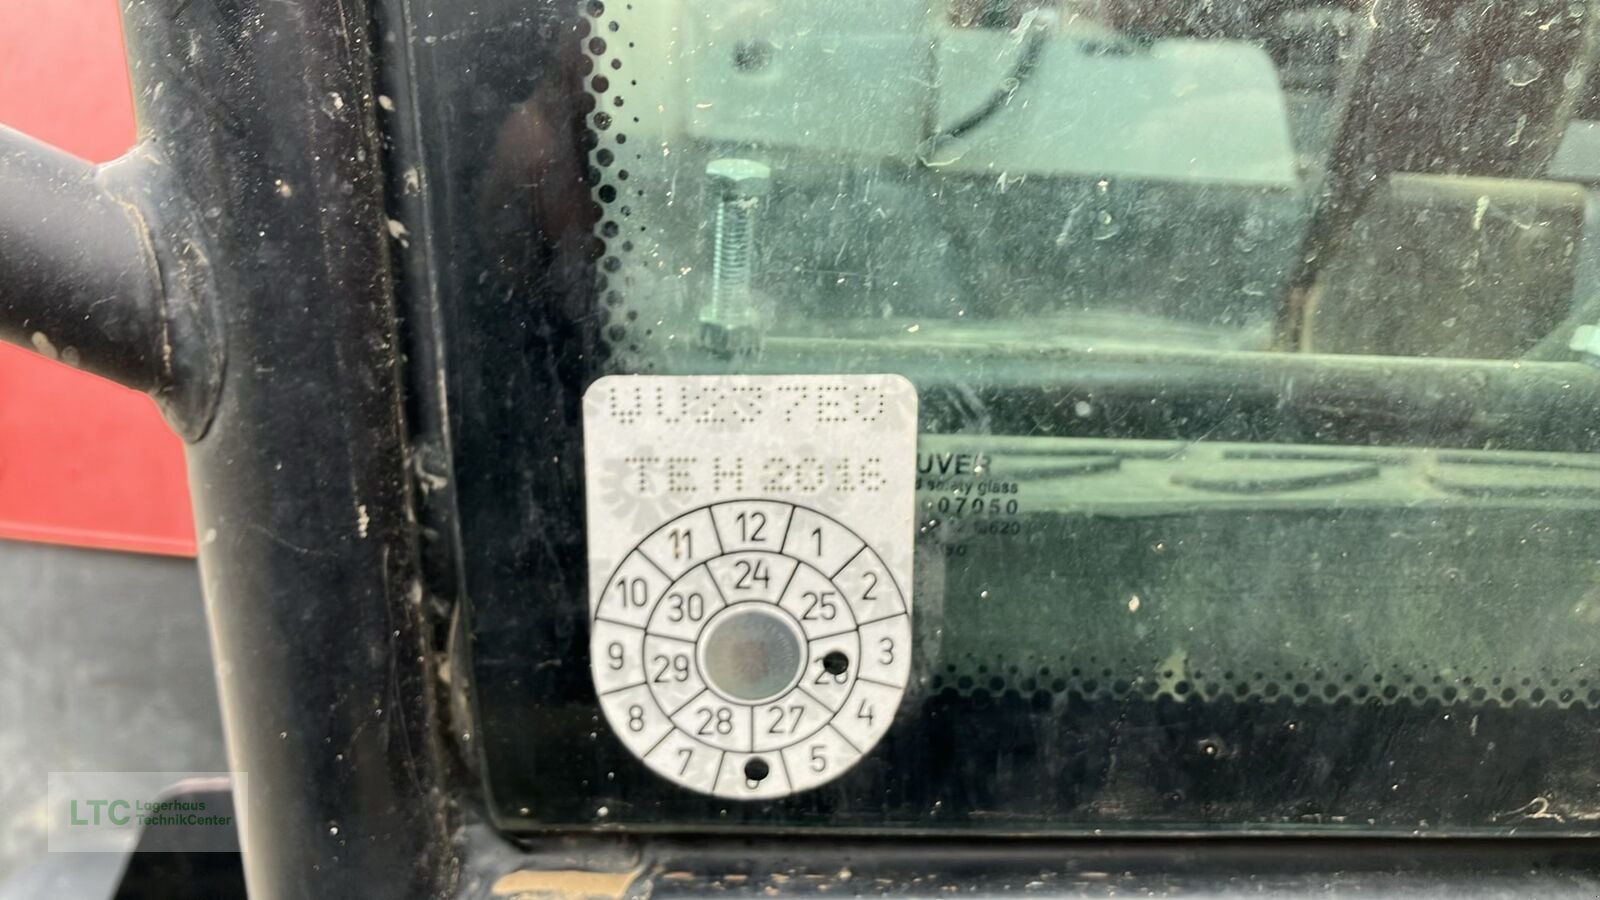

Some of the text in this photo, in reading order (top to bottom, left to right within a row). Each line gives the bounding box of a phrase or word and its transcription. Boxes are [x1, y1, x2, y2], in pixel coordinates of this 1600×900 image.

[917, 453, 992, 475] UVER
[927, 480, 972, 495] saety
[978, 480, 1019, 496] glass
[736, 512, 767, 542] 12
[668, 527, 693, 560] 11
[811, 527, 822, 557] 1
[734, 559, 770, 589] 24
[862, 572, 878, 601] 2
[617, 577, 648, 607] 10
[801, 592, 837, 620] 25
[668, 592, 704, 622] 30
[608, 641, 625, 670] 9
[879, 637, 894, 665] 3
[654, 654, 689, 683] 29
[629, 705, 645, 732] 8
[698, 707, 733, 735] 28
[768, 706, 804, 734] 27
[857, 698, 874, 726] 4
[678, 748, 693, 776] 7
[810, 745, 827, 772] 5
